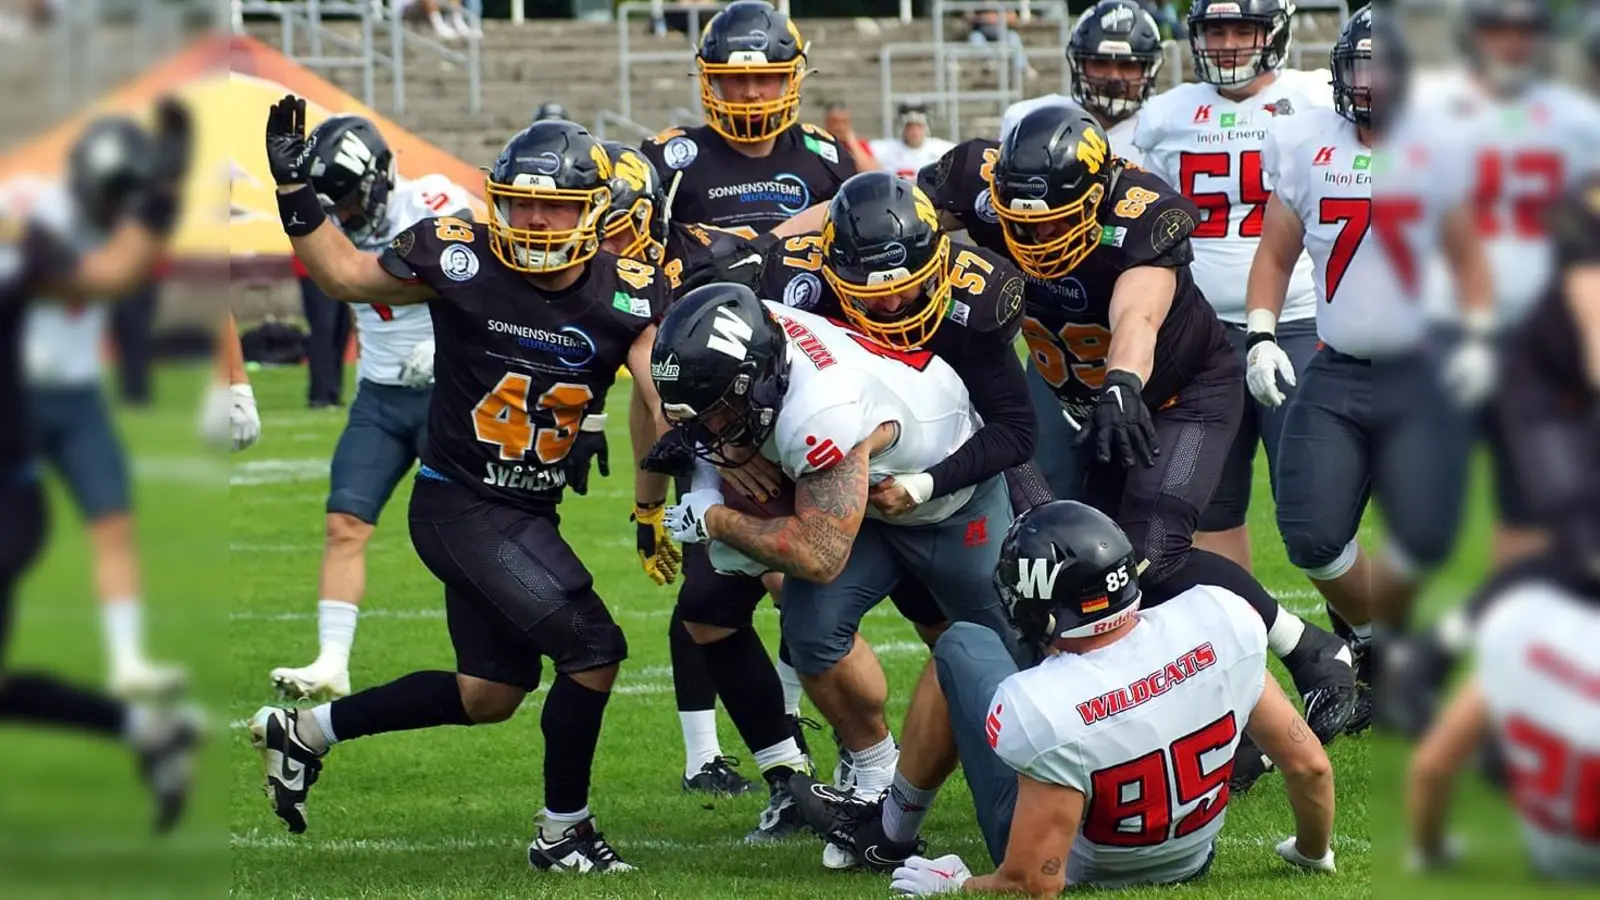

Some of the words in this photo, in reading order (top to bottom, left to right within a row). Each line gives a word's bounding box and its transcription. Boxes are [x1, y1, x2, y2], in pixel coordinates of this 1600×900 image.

[708, 180, 801, 200] SONNENSYSTEME
[950, 250, 994, 295] 57
[706, 305, 753, 361] W
[471, 371, 593, 464] 43
[1018, 558, 1064, 599] W
[1105, 565, 1129, 592] 85
[1076, 642, 1217, 725] WILDCATS
[1083, 710, 1237, 847] 85
